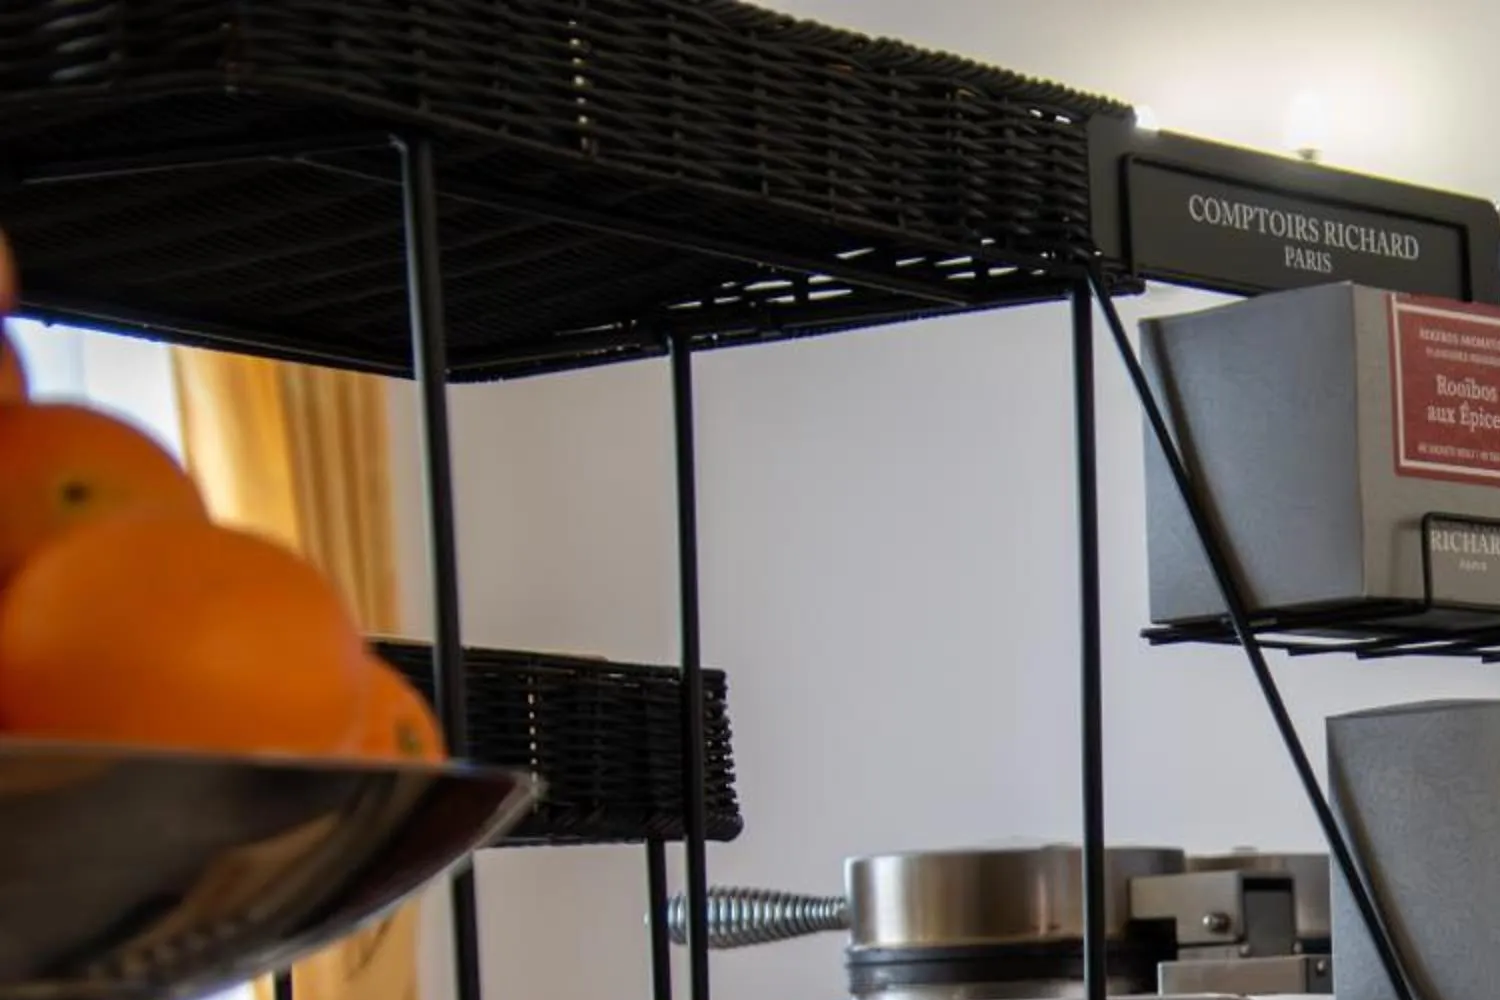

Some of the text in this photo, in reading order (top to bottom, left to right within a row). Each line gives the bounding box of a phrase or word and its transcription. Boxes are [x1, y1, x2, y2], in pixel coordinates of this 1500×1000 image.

[1188, 194, 1419, 260] COMPTOIRS RICHARD
[1284, 245, 1332, 273] PARIS
[1427, 405, 1455, 423] aux
